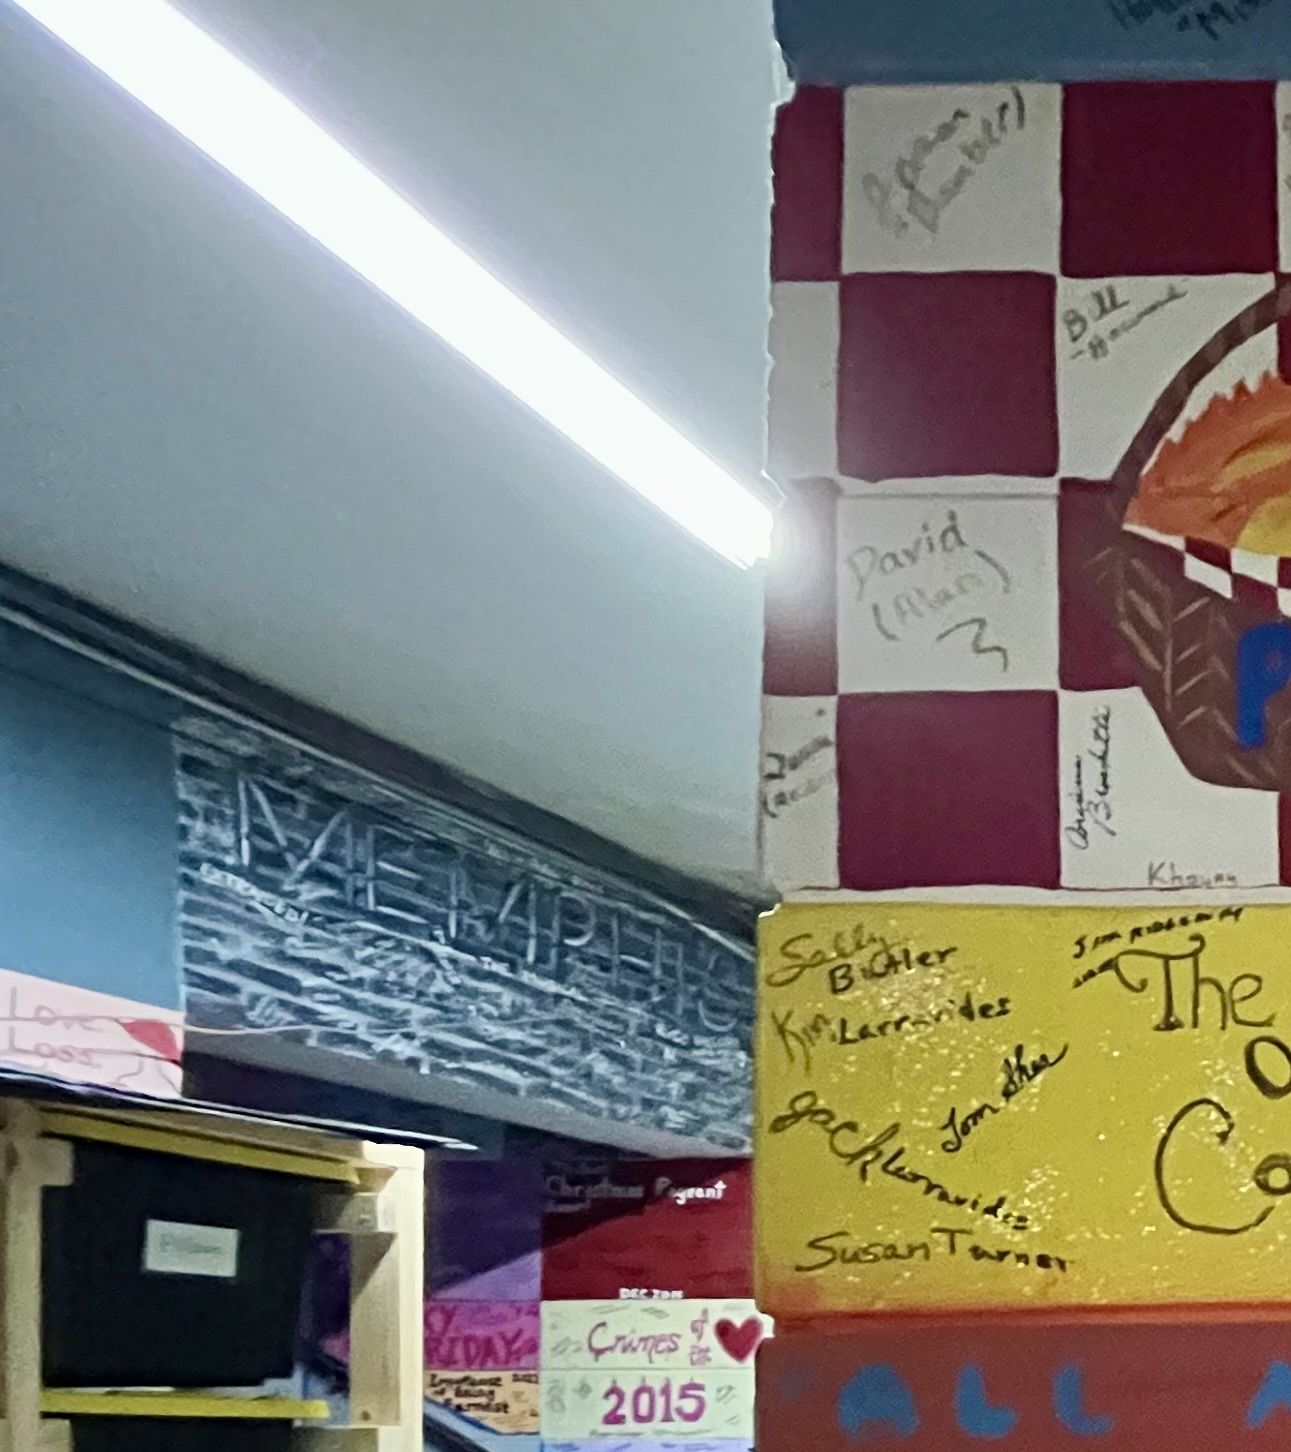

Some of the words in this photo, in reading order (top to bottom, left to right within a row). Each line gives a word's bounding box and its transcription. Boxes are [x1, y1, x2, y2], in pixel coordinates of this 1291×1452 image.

[1114, 932, 1277, 1032] The
[586, 1319, 684, 1366] Crimes
[601, 1381, 708, 1426] 2015
[836, 1359, 1116, 1445] ALL
